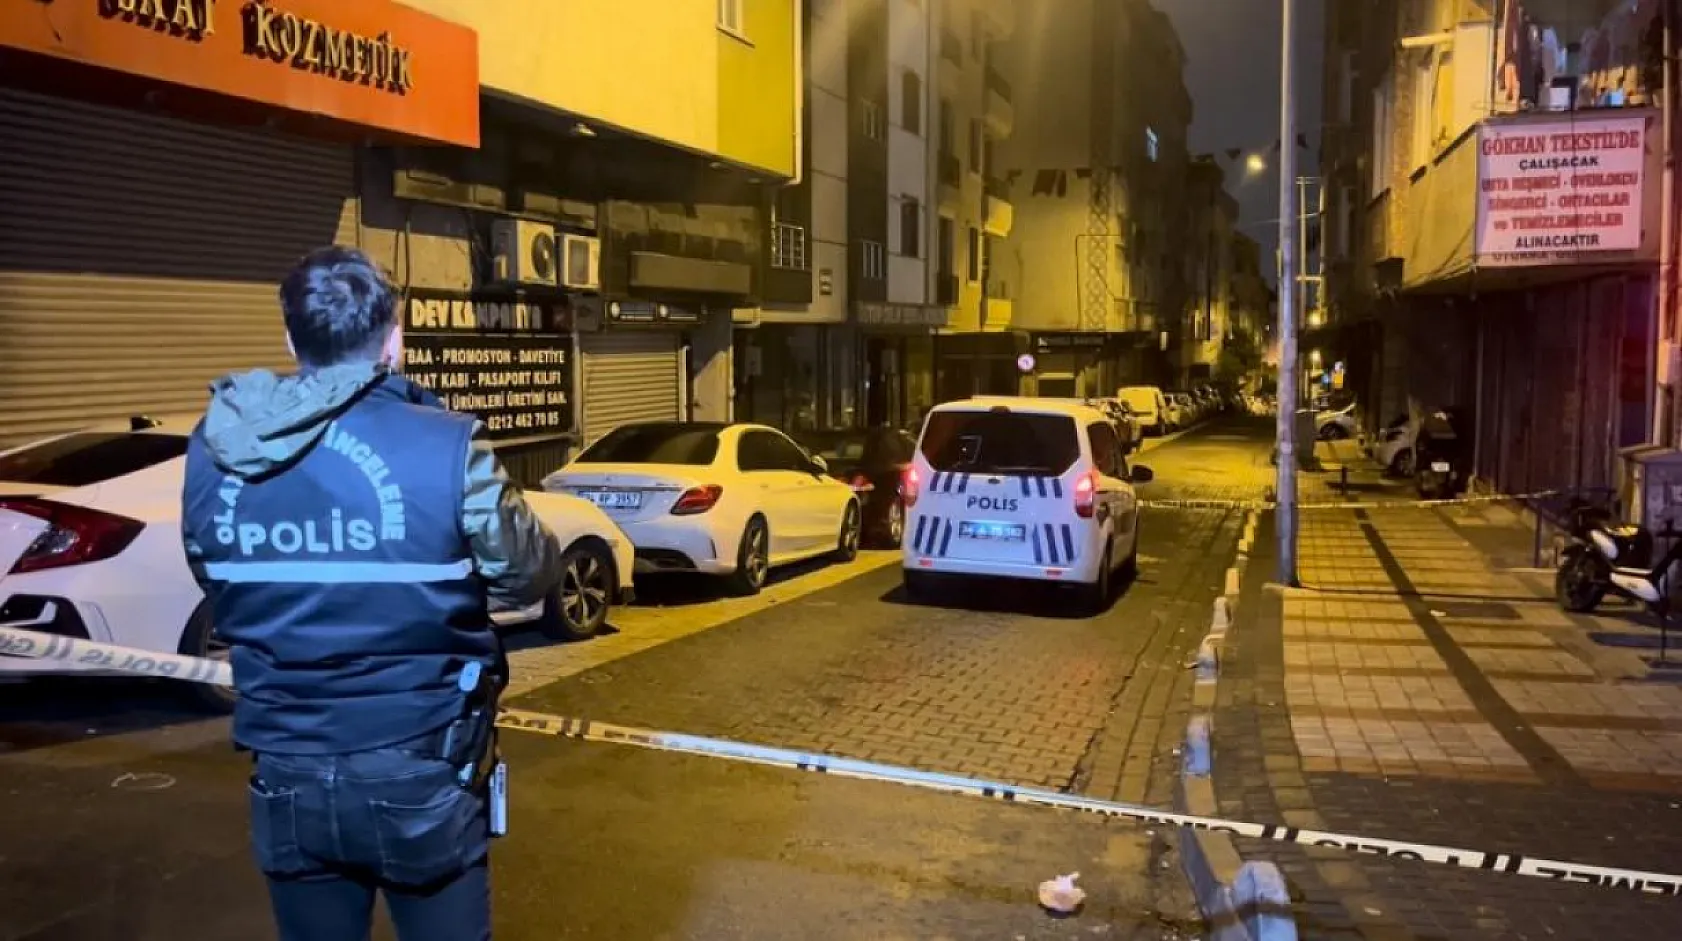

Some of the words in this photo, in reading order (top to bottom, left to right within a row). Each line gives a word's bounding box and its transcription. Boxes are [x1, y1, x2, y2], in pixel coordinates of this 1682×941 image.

[256, 3, 414, 90] KOZMETİK
[1482, 132, 1546, 155] GÖKHAN
[1519, 156, 1598, 170] ÇALIŞACAK
[1515, 234, 1600, 248] ALINACAKTIR
[443, 349, 511, 363] PROMOSYON
[478, 371, 531, 387] PASAPORT
[239, 508, 377, 555] POLİS
